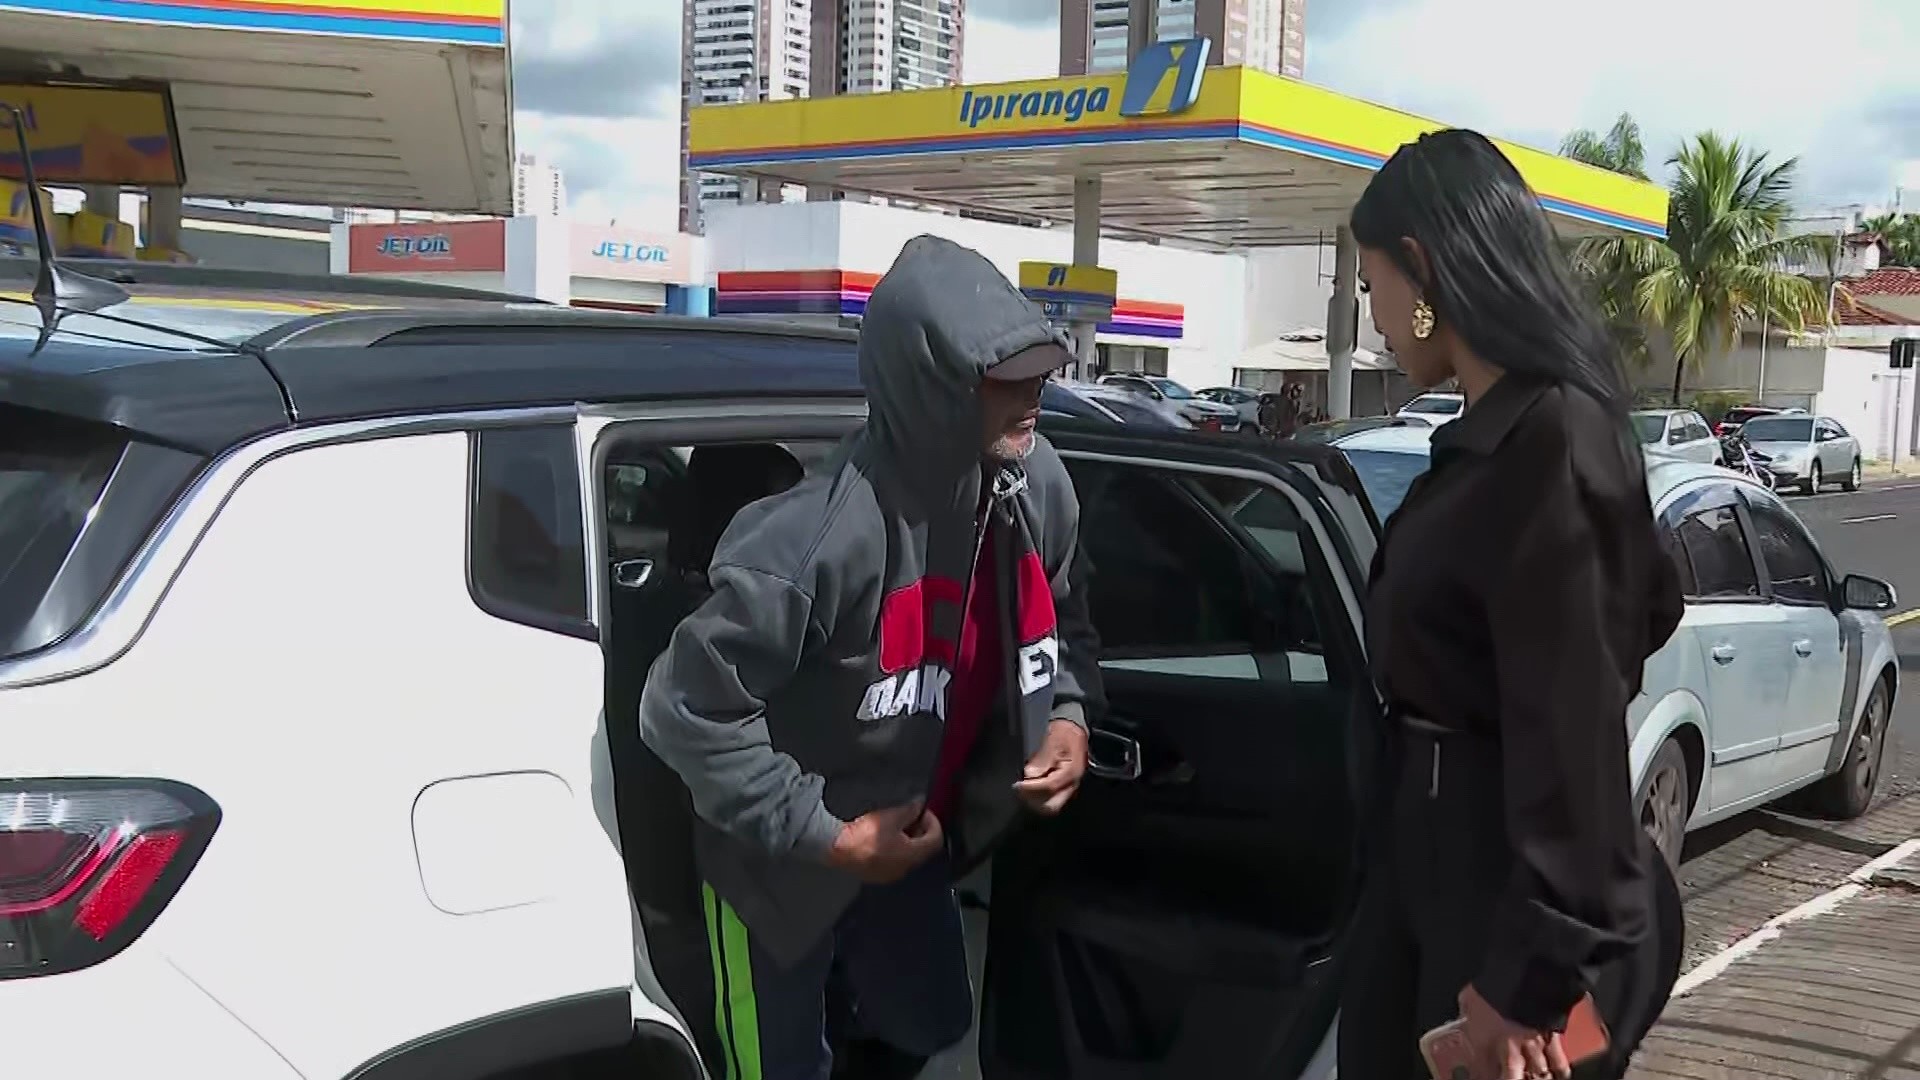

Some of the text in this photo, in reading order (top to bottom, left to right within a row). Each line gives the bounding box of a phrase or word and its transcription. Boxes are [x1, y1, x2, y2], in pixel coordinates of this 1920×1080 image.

[959, 86, 1110, 128] Ipiranga
[376, 237, 412, 254] JET
[592, 241, 633, 258] JET
